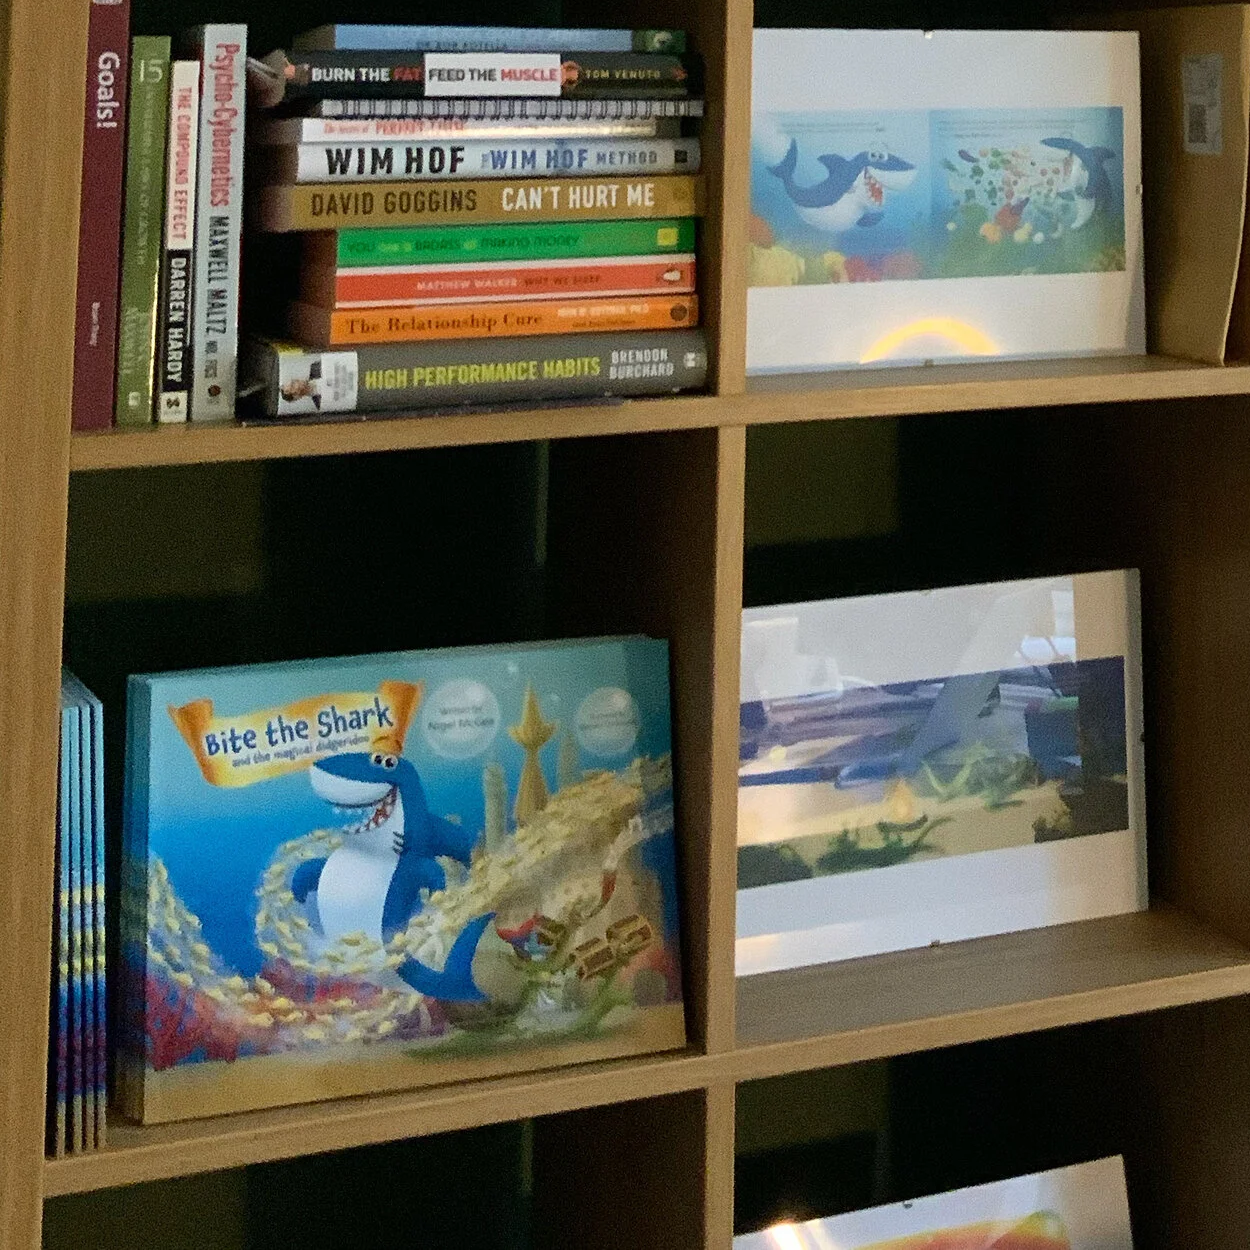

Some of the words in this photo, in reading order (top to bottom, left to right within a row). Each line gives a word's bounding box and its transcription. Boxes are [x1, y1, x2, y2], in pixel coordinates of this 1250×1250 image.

[96, 51, 121, 128] Goals!
[311, 67, 356, 82] BURN
[359, 67, 391, 82] THE
[429, 69, 466, 82] FEED
[468, 69, 497, 82] THE
[501, 68, 559, 82] MUSCLE
[585, 69, 610, 80] TOM
[177, 87, 193, 111] THE
[325, 147, 394, 175] WIM
[405, 146, 465, 174] HOF
[491, 149, 537, 170] WIM
[546, 148, 588, 169] HOF
[597, 151, 658, 166] METHOD
[173, 189, 189, 240] EFFECT
[311, 191, 374, 217] DAVID
[384, 189, 478, 215] GOGGINS
[501, 185, 561, 212] CAN'T
[569, 184, 620, 210] HURT
[627, 183, 656, 207] ME
[208, 216, 229, 284] MAXWELL
[168, 257, 187, 323] DARREN
[416, 279, 470, 291] MATTHEW
[474, 277, 518, 289] WALKER
[206, 288, 228, 335] MALTZ
[346, 318, 379, 335] The
[388, 313, 498, 332] Relationship
[503, 312, 543, 327] Cure
[166, 327, 185, 383] HARDY
[609, 362, 675, 380] BURCHARD
[611, 348, 668, 364] BRENDON
[365, 368, 408, 390] HIGH
[413, 360, 538, 387] PERFORMANCE
[544, 356, 601, 379] HABITS
[205, 727, 257, 756] Bite
[265, 714, 309, 748] the
[317, 696, 395, 739] Shark
[232, 753, 251, 768] and
[253, 749, 271, 765] the
[274, 743, 313, 762] magical
